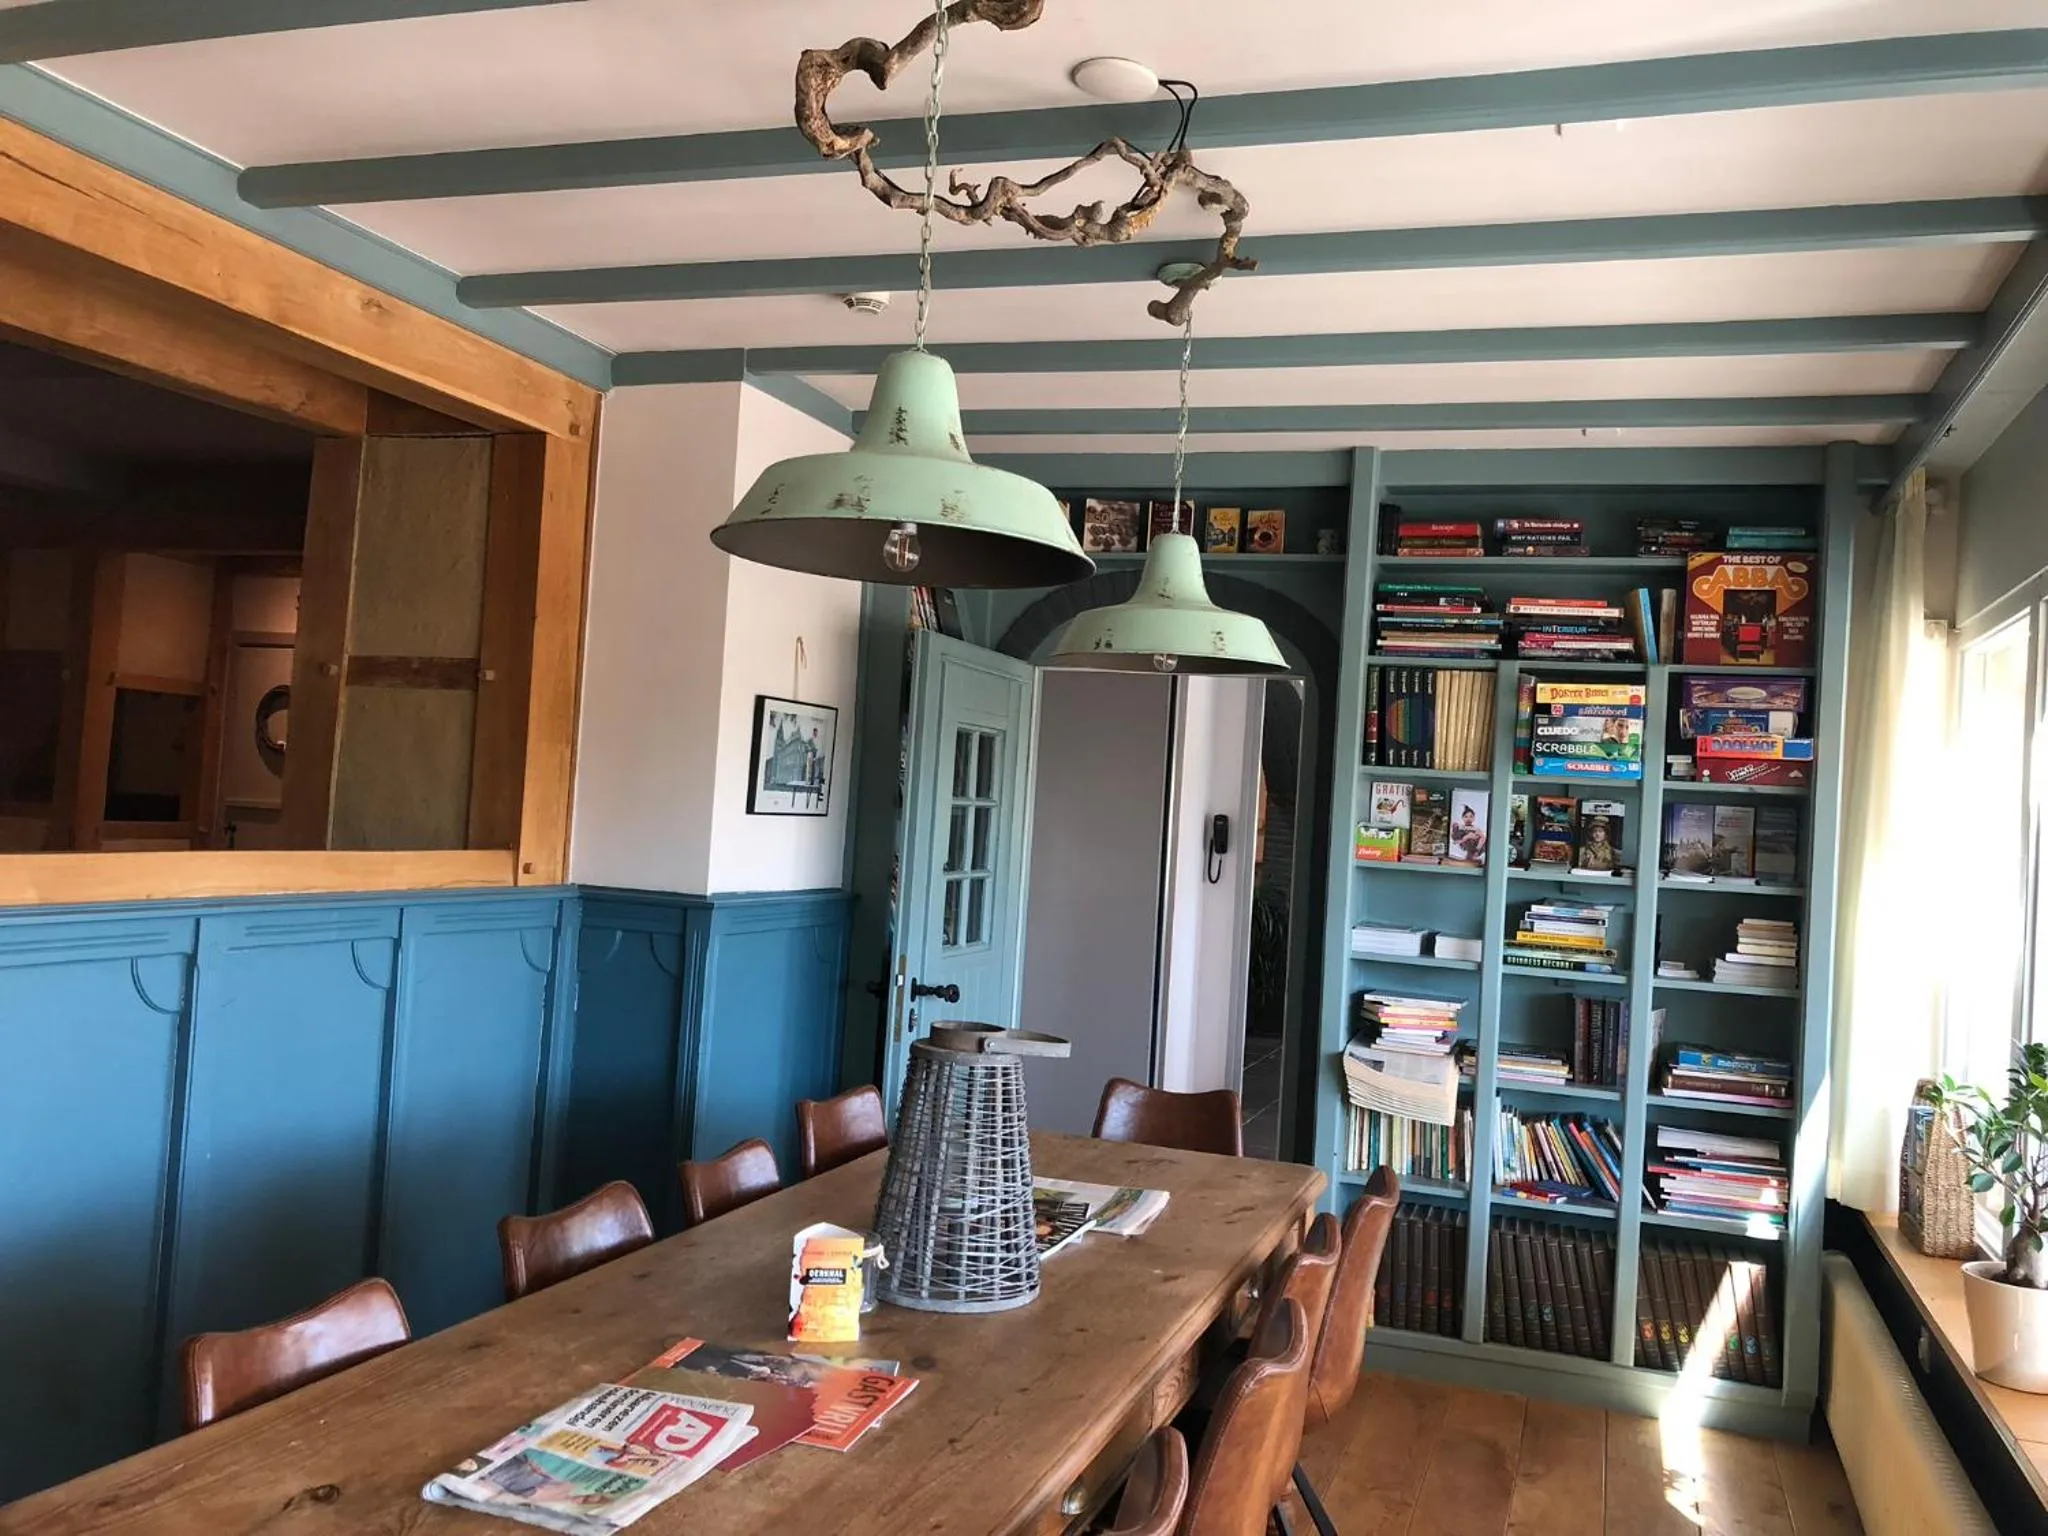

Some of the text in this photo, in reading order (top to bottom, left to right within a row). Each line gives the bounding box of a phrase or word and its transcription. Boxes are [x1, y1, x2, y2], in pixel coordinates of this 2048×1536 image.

[1722, 556, 1782, 564] THE BEST OF
[1537, 726, 1580, 735] CLUEDO
[1535, 742, 1597, 755] SCRABBLE
[1566, 762, 1611, 772] SCRABBLE
[1375, 783, 1412, 797] GRATIS
[654, 1411, 714, 1452] AD
